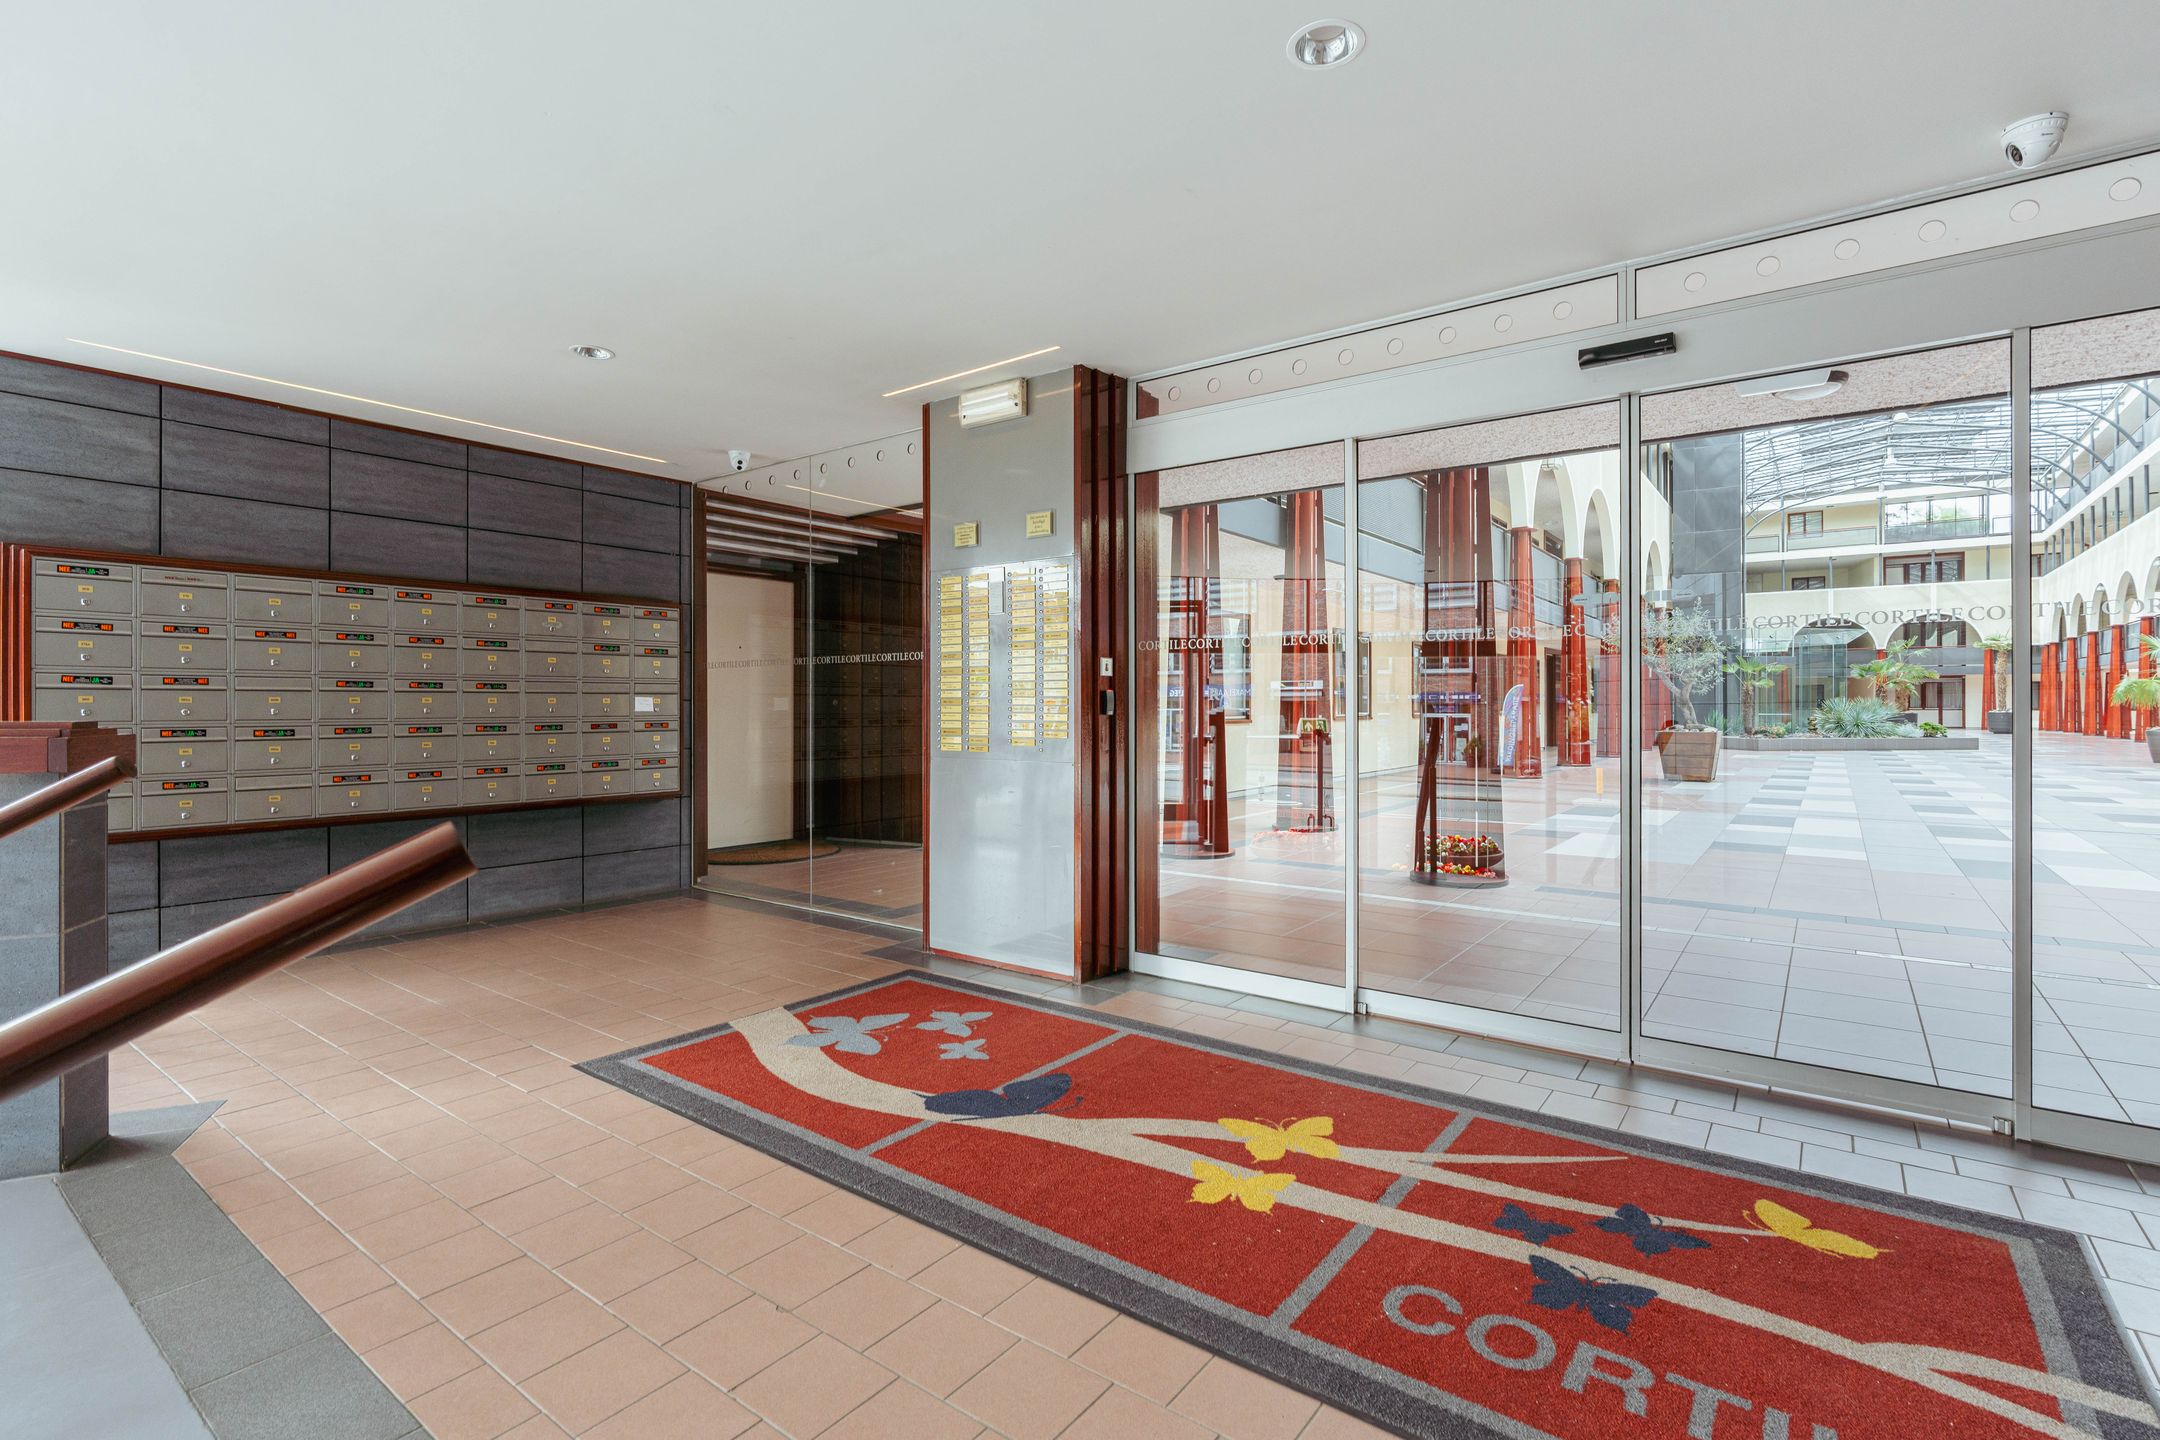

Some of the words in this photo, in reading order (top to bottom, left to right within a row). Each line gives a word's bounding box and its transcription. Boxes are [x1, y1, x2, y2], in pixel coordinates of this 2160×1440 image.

[58, 565, 71, 573] NEE
[87, 567, 97, 575] JA
[62, 675, 74, 683] NEE
[91, 676, 101, 684] JA
[1381, 1284, 1838, 1440] CORTI
